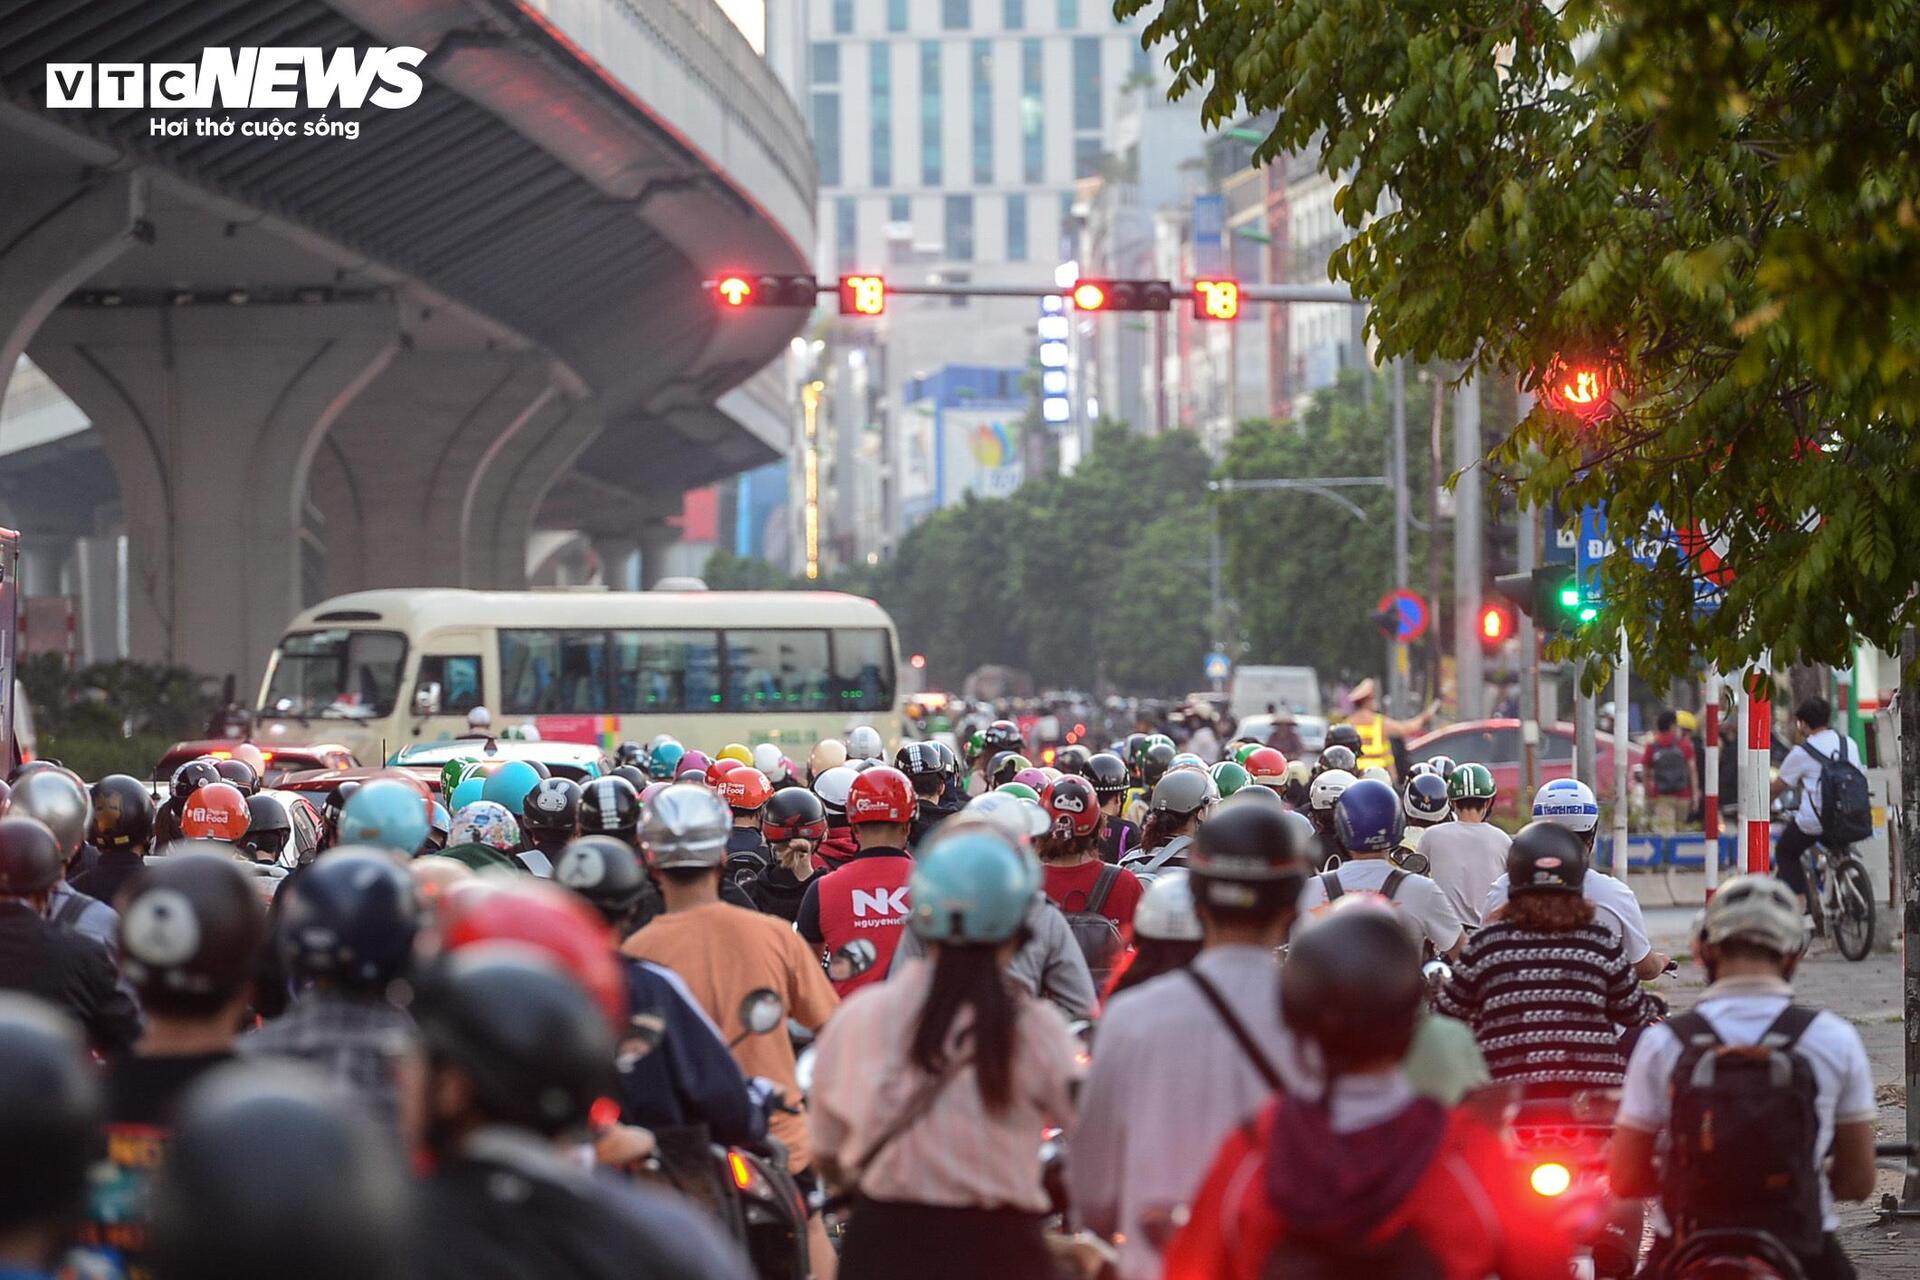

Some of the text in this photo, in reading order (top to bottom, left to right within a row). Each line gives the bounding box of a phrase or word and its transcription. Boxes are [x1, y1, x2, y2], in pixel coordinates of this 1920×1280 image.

[727, 787, 745, 795] Food
[206, 813, 229, 824] Food
[851, 886, 911, 917] NK
